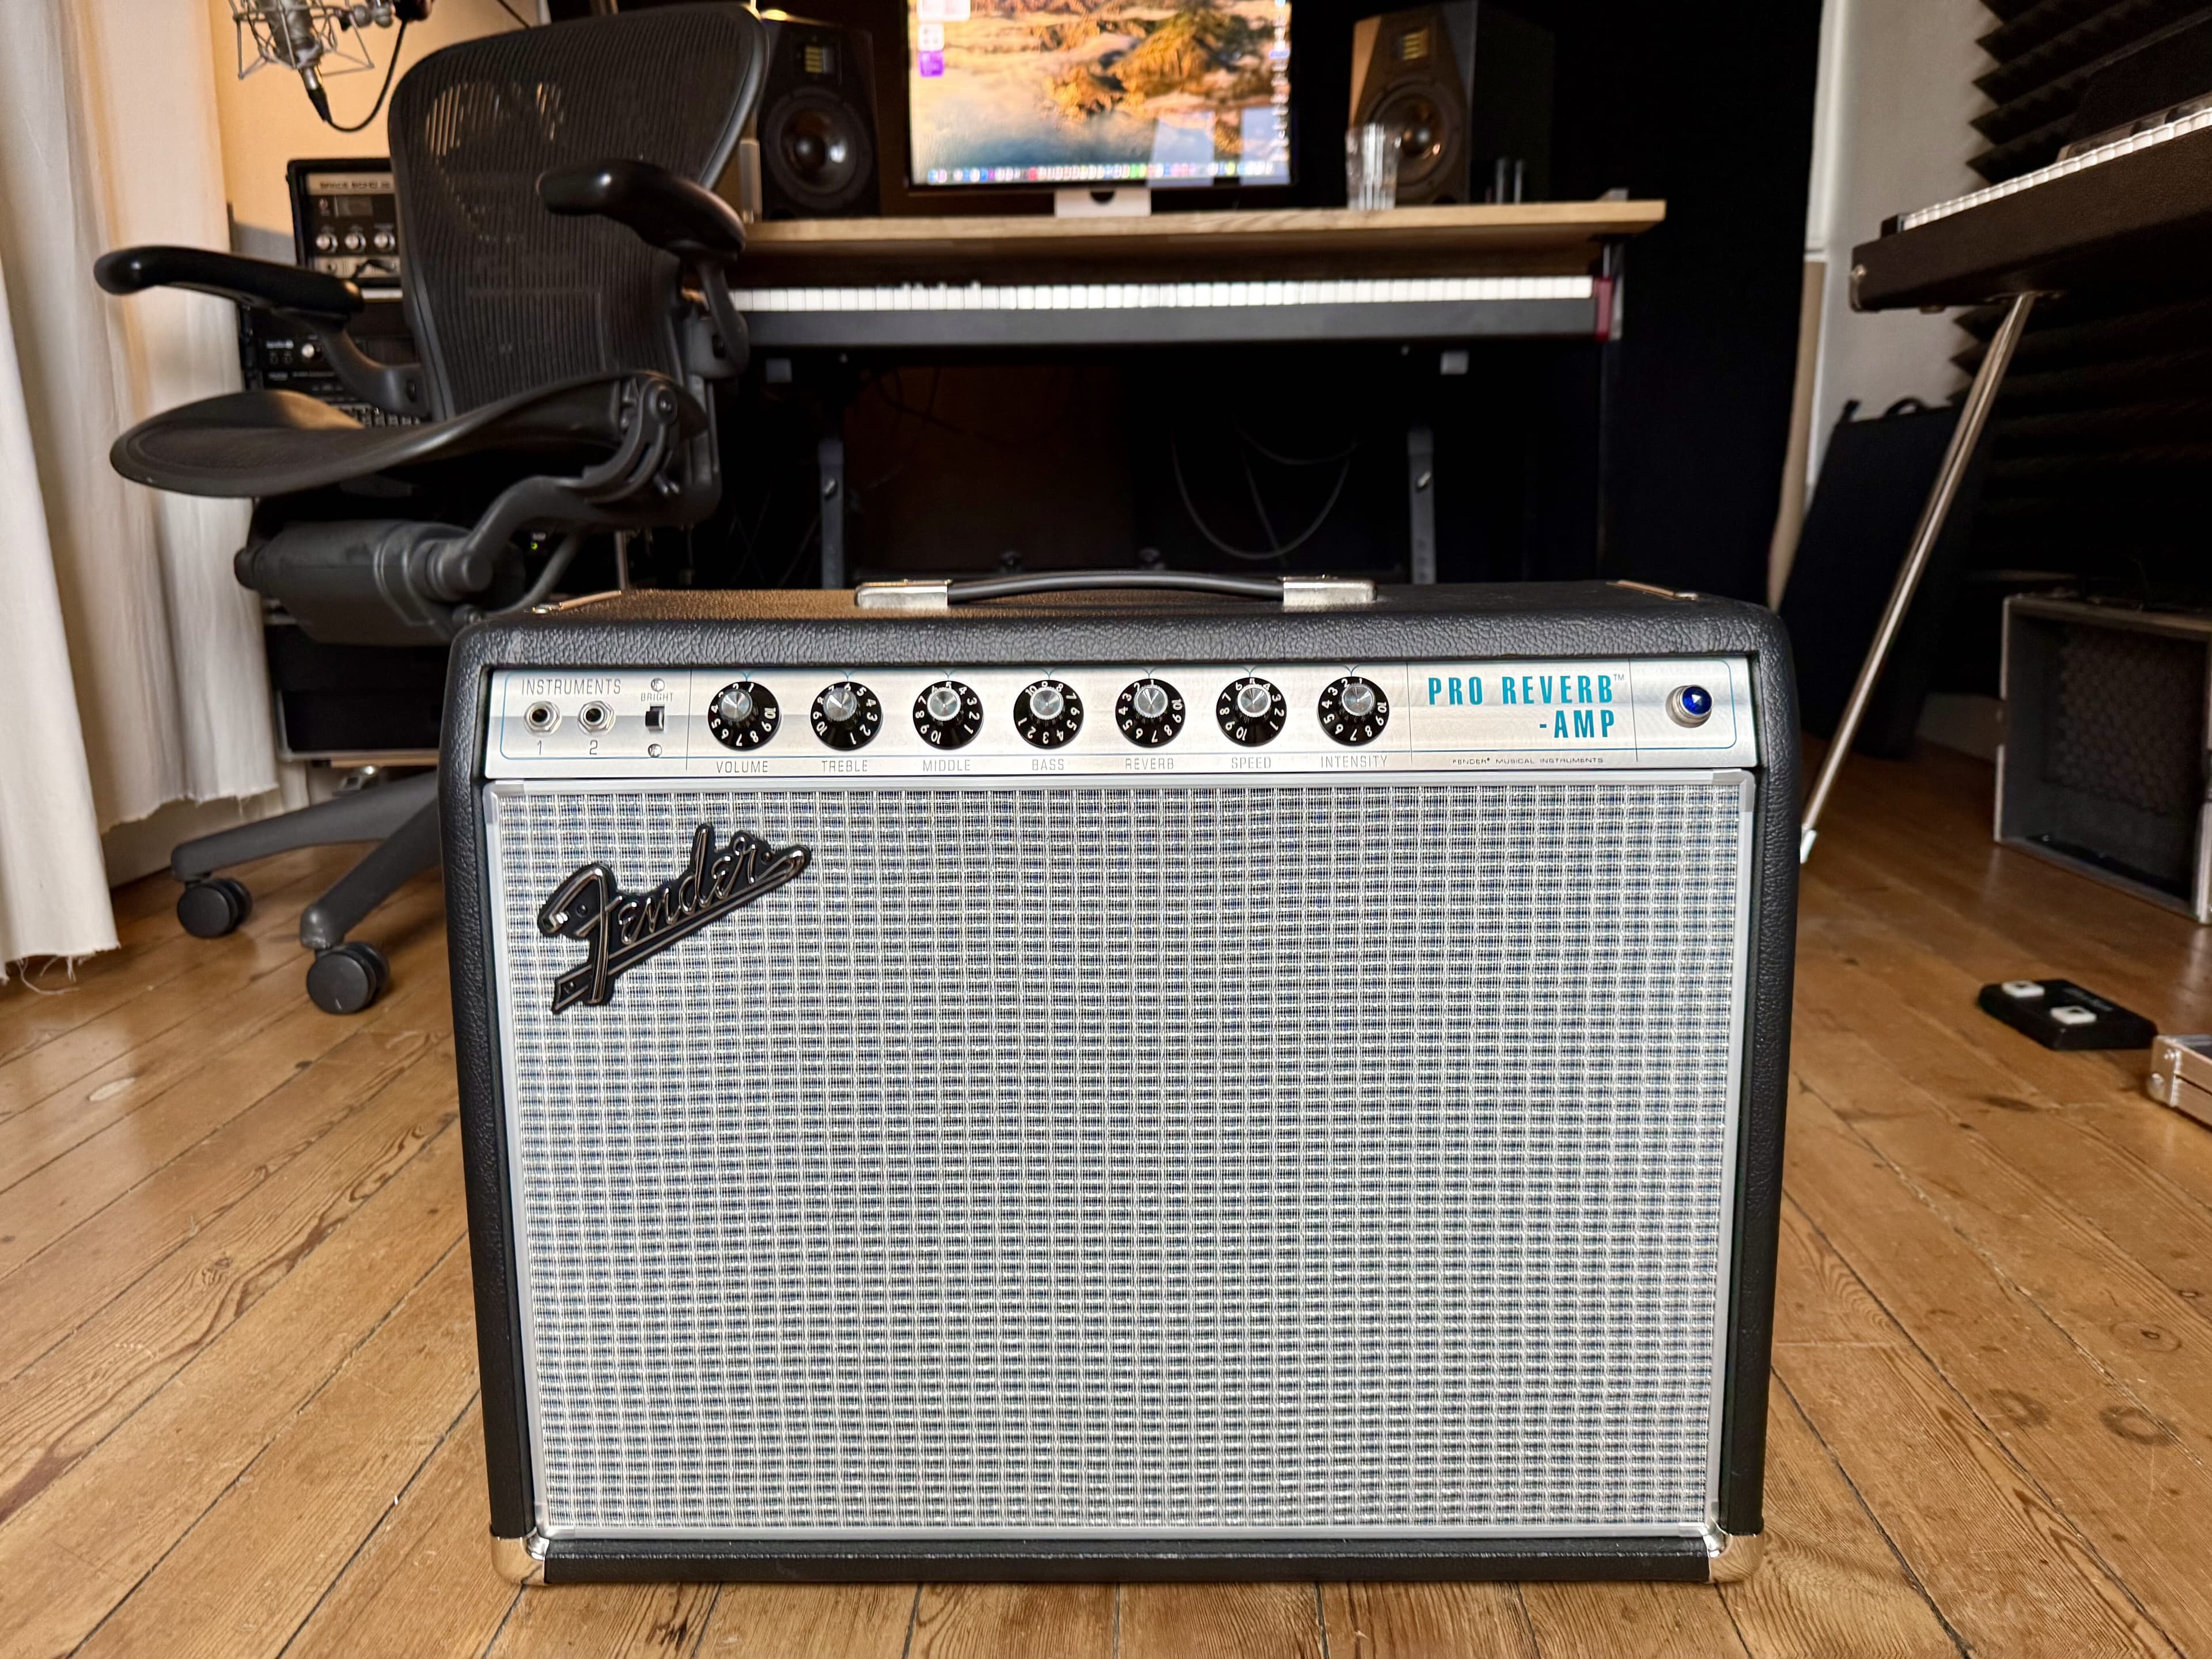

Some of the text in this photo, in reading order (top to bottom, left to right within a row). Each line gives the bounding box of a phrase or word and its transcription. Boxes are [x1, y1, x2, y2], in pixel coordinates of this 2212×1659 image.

[521, 678, 621, 696] INSTRUMENTS
[748, 683, 754, 692] 1
[844, 683, 851, 691] 6
[1056, 683, 1063, 692] 8
[1236, 682, 1243, 691] 6
[1263, 683, 1271, 691] 4
[1341, 679, 1350, 688] 2
[857, 687, 866, 696] 5
[959, 687, 967, 695] 4
[1025, 685, 1037, 696] 10
[1328, 687, 1338, 696] 3
[1429, 676, 1483, 705] PRO
[641, 692, 673, 702] BRIGHT
[918, 695, 926, 704] 7
[967, 697, 978, 706] 3
[1122, 693, 1132, 702] 3
[1222, 692, 1231, 702] 7
[711, 704, 719, 713] 4
[866, 699, 876, 707] 4
[1172, 699, 1183, 710] 10
[1321, 700, 1332, 709] 4
[1377, 702, 1387, 713] 10
[764, 707, 776, 719] 10
[813, 711, 822, 719] 9
[915, 710, 925, 718] 8
[969, 711, 980, 720] 2
[1070, 707, 1080, 715] 6
[1118, 706, 1128, 715] 4
[1219, 707, 1230, 715] 8
[1275, 708, 1285, 717] 2
[866, 712, 878, 721] 3
[1018, 718, 1027, 726] 1
[1172, 714, 1181, 723] 9
[1324, 713, 1335, 724] 5
[1376, 715, 1384, 726] 9
[711, 718, 721, 729] 5
[762, 721, 771, 732] 9
[816, 721, 827, 736] 10
[921, 724, 930, 734] 9
[964, 724, 974, 734] 1
[1067, 720, 1077, 730] 5
[1123, 719, 1132, 730] 5
[1225, 721, 1235, 730] 9
[1270, 721, 1279, 731] 1
[1335, 724, 1343, 734] 6
[721, 729, 729, 739] 6
[859, 724, 871, 736] 2
[1027, 726, 1036, 739] 2
[1056, 729, 1063, 741] 4
[1135, 728, 1143, 739] 6
[1164, 725, 1172, 736] 8
[1236, 726, 1247, 741] 10
[1350, 729, 1357, 741] 7
[1365, 725, 1372, 737] 8
[736, 734, 743, 746] 7
[750, 730, 759, 743] 8
[850, 733, 857, 745] 1
[931, 730, 941, 744] 10
[1043, 732, 1050, 744] 3
[1152, 730, 1158, 743] 7
[537, 740, 542, 756] 1
[589, 740, 599, 755] 2
[717, 761, 768, 773] VOLUME
[822, 760, 868, 772] TREBLE
[923, 759, 971, 771] MIDDLE
[1032, 759, 1064, 771] BASS
[1126, 758, 1173, 770] REVERB
[1232, 757, 1271, 769] SPEED
[1321, 756, 1387, 768] INTENSITY
[539, 823, 810, 1013] Fender
